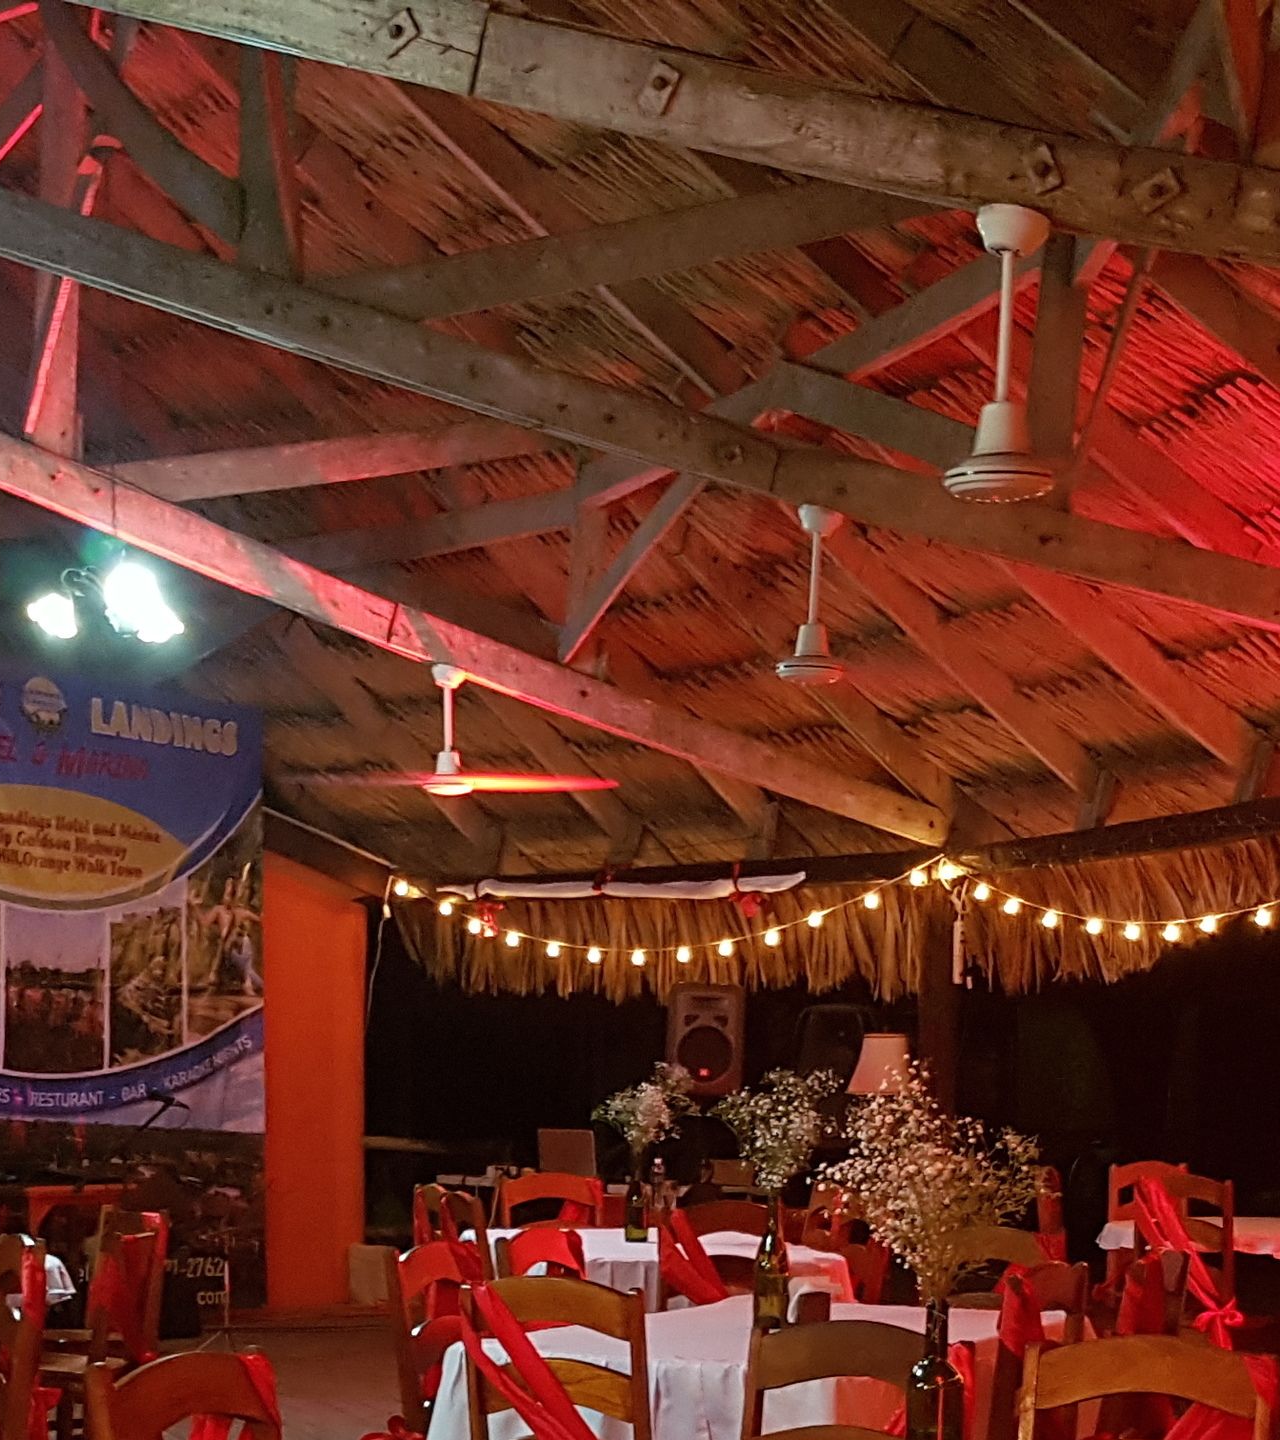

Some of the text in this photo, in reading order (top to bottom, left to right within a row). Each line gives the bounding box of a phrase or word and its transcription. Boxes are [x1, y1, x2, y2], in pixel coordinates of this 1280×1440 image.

[91, 697, 238, 757] LANDINGS
[93, 822, 116, 837] and
[73, 855, 108, 875] Walk
[111, 860, 143, 878] Town
[29, 1089, 105, 1107] RESTURANT
[121, 1083, 147, 1101] BAR
